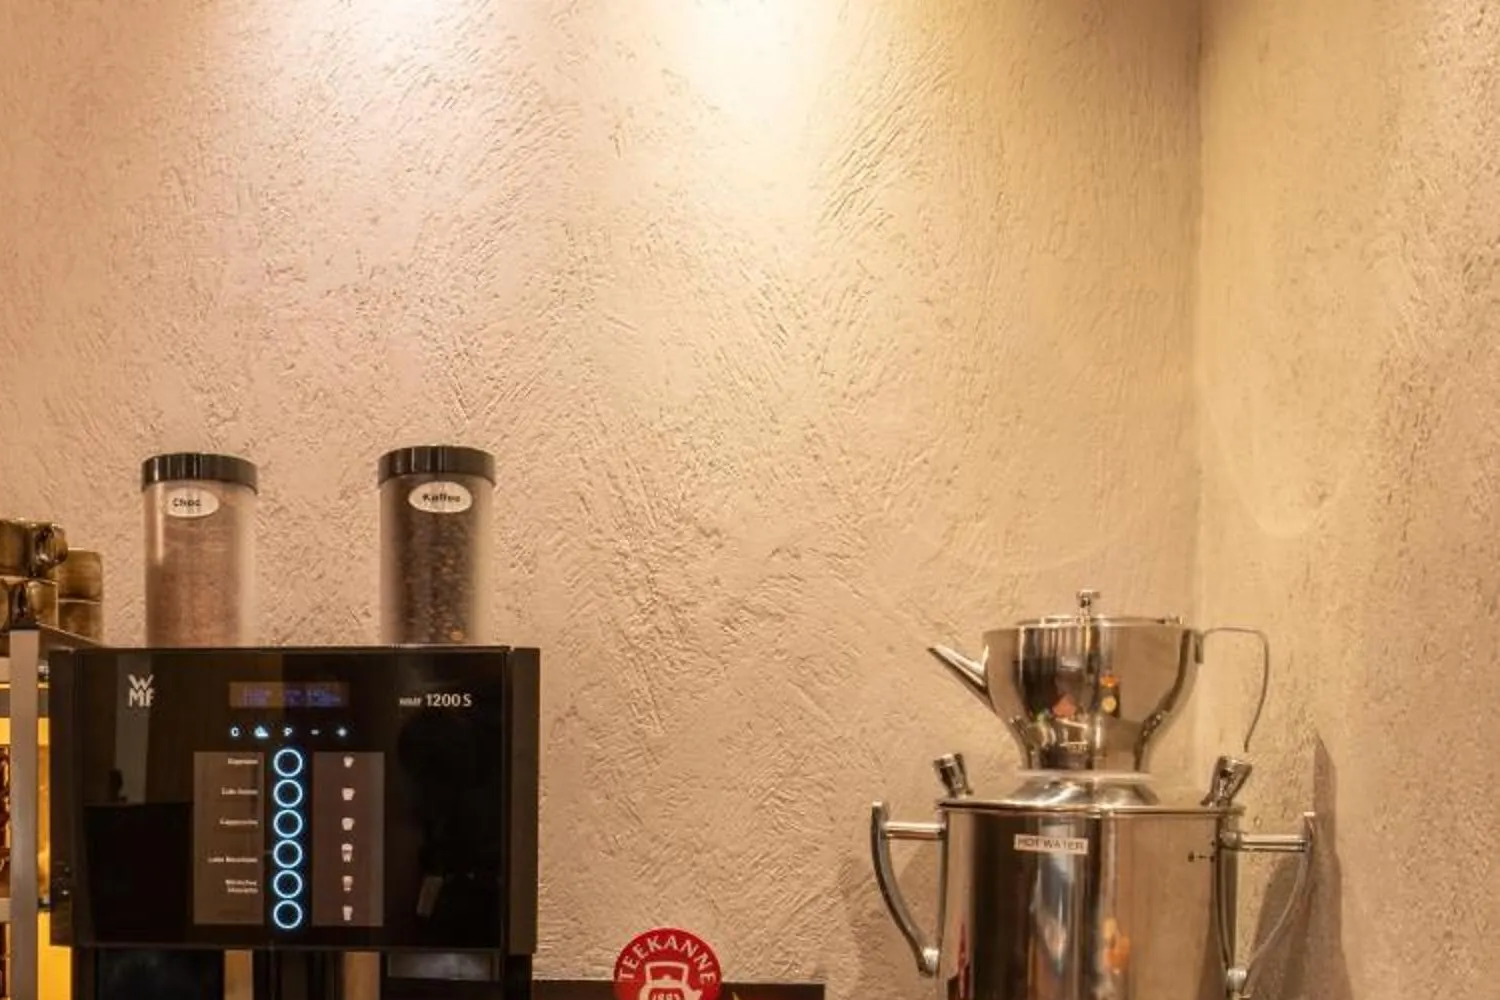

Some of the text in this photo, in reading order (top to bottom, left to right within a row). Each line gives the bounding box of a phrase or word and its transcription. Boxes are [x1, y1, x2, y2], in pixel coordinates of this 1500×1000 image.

[128, 674, 154, 707] WMF
[425, 693, 461, 707] 1200
[463, 693, 473, 707] S
[1043, 839, 1084, 851] WATER
[619, 935, 717, 985] TEEKANNE
